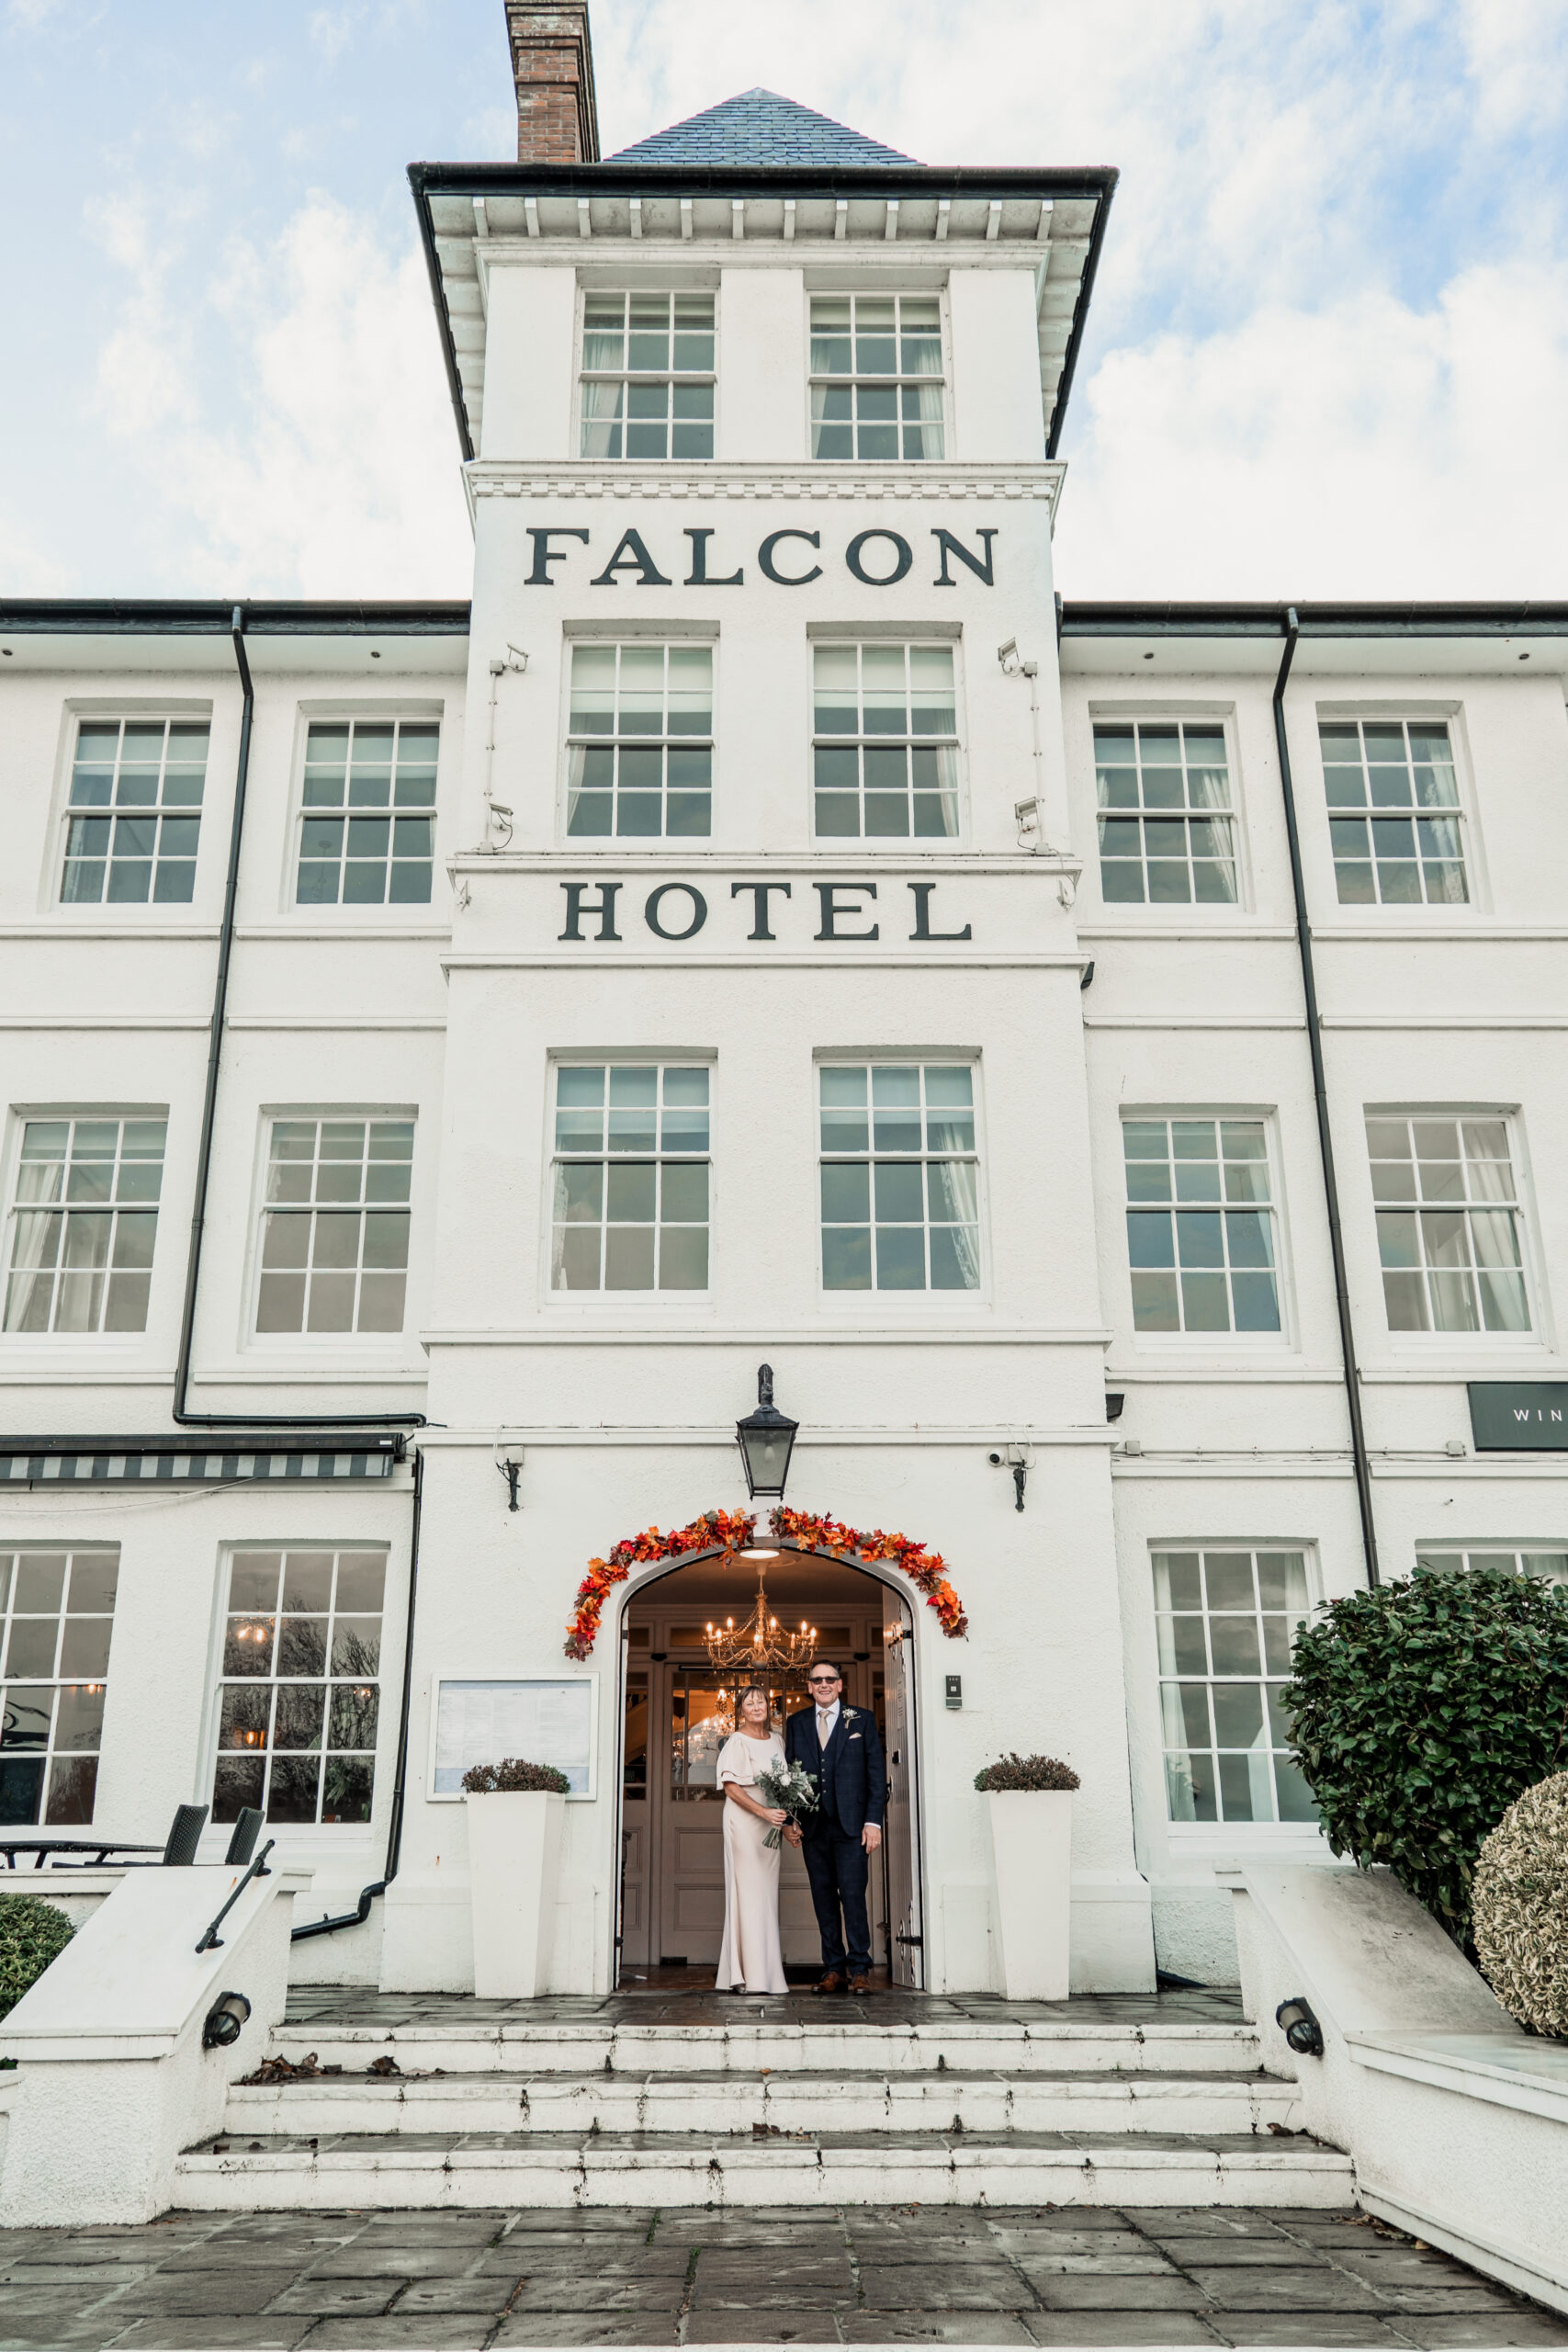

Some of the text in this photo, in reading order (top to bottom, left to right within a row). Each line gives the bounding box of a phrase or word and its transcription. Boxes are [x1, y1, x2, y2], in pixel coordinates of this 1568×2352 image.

[524, 527, 999, 586] FALCON
[557, 882, 973, 942] HOTEL
[1513, 1408, 1562, 1422] WIN
